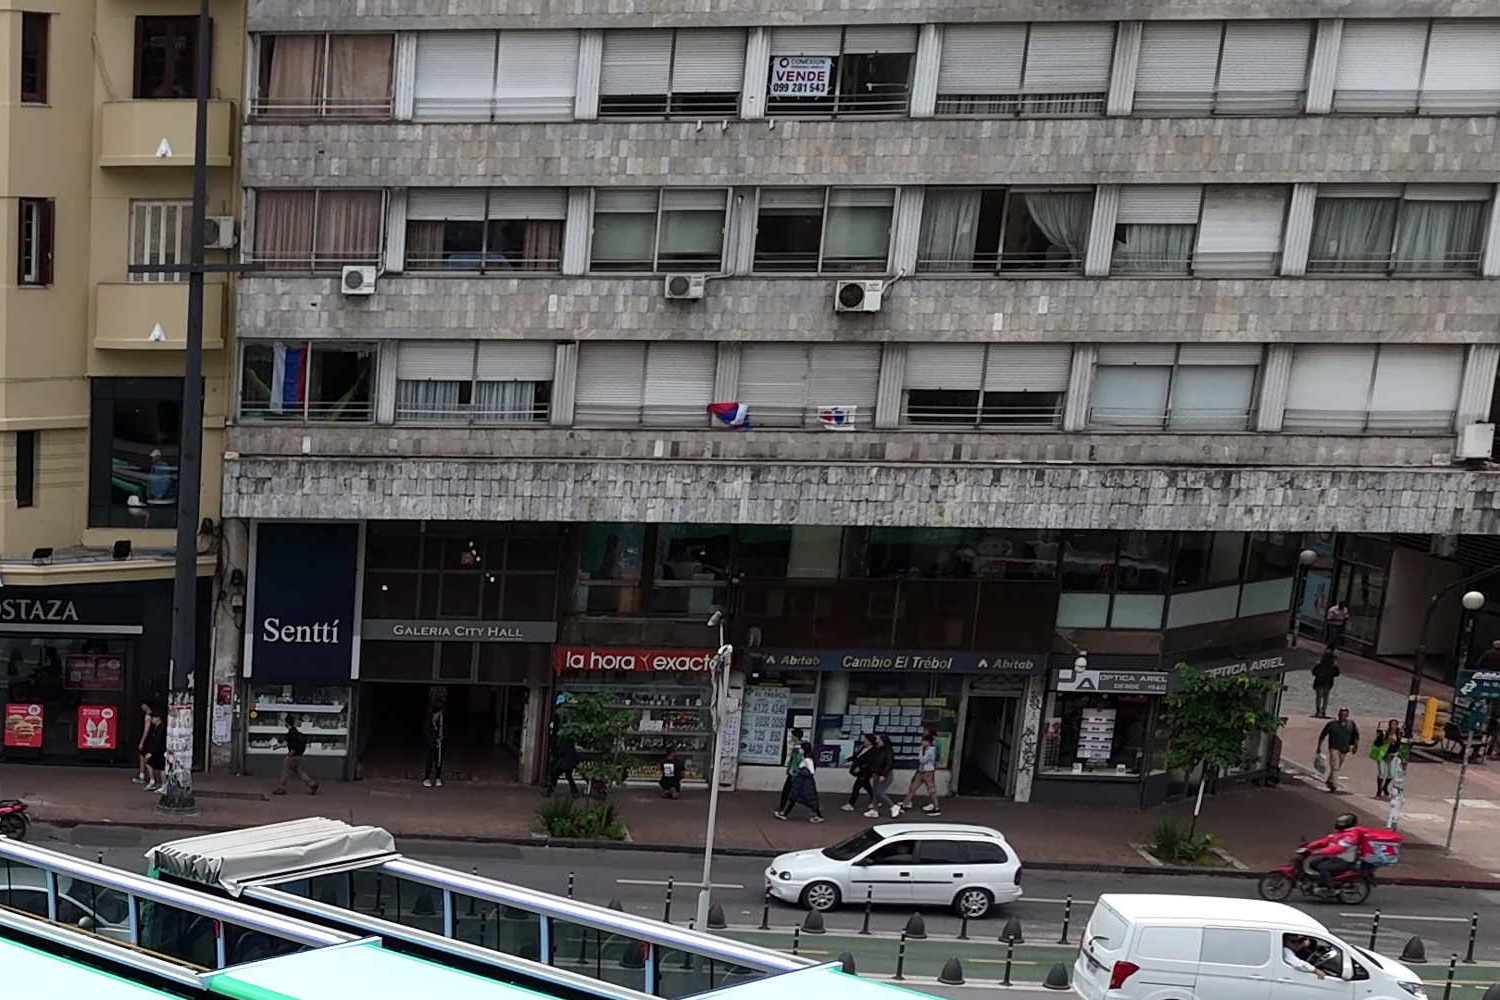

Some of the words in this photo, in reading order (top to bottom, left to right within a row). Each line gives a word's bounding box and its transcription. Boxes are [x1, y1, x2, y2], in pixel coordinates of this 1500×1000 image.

[776, 70, 826, 82] VENDE
[773, 83, 789, 93] 099
[791, 83, 807, 93] 281
[809, 83, 826, 93] 543
[263, 617, 340, 644] Senttí
[392, 624, 451, 637] GALERIA
[454, 625, 485, 638] CITY
[487, 626, 523, 638] HALL
[565, 650, 584, 669] la
[589, 651, 636, 671] hora
[780, 655, 821, 666] Abitab
[842, 655, 892, 668] Cambio
[894, 656, 908, 668] El
[912, 656, 953, 669] Trébol
[992, 659, 1034, 670] Abitab
[1249, 656, 1286, 673] ARIEL
[1100, 674, 1136, 682] OPTICA
[1139, 675, 1168, 683] ARIEL
